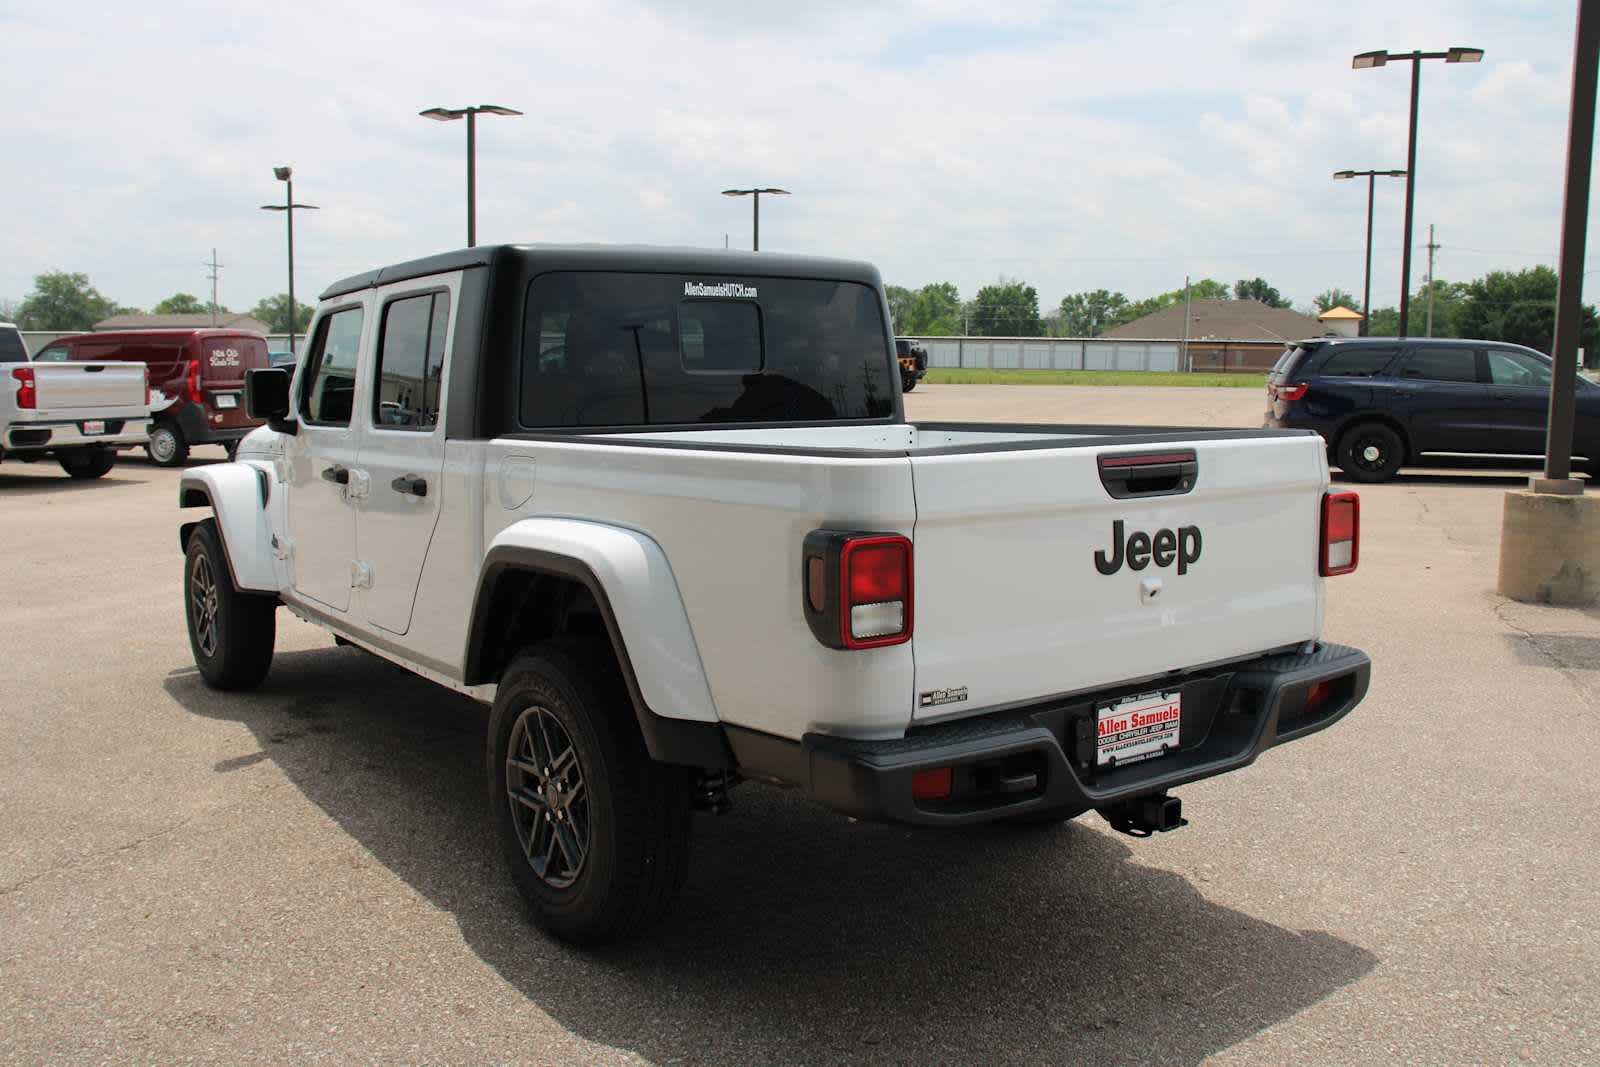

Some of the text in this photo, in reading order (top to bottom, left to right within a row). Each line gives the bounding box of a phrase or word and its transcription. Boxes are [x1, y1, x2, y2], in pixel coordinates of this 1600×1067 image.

[684, 282, 758, 298] AllenSamuelsHUTCH.com
[1094, 519, 1203, 576] Jeep
[1098, 706, 1179, 736] Allen Samuels
[1098, 735, 1118, 746] DODGE
[1119, 728, 1148, 740] CHRYSLER
[1149, 723, 1164, 733] JEEP
